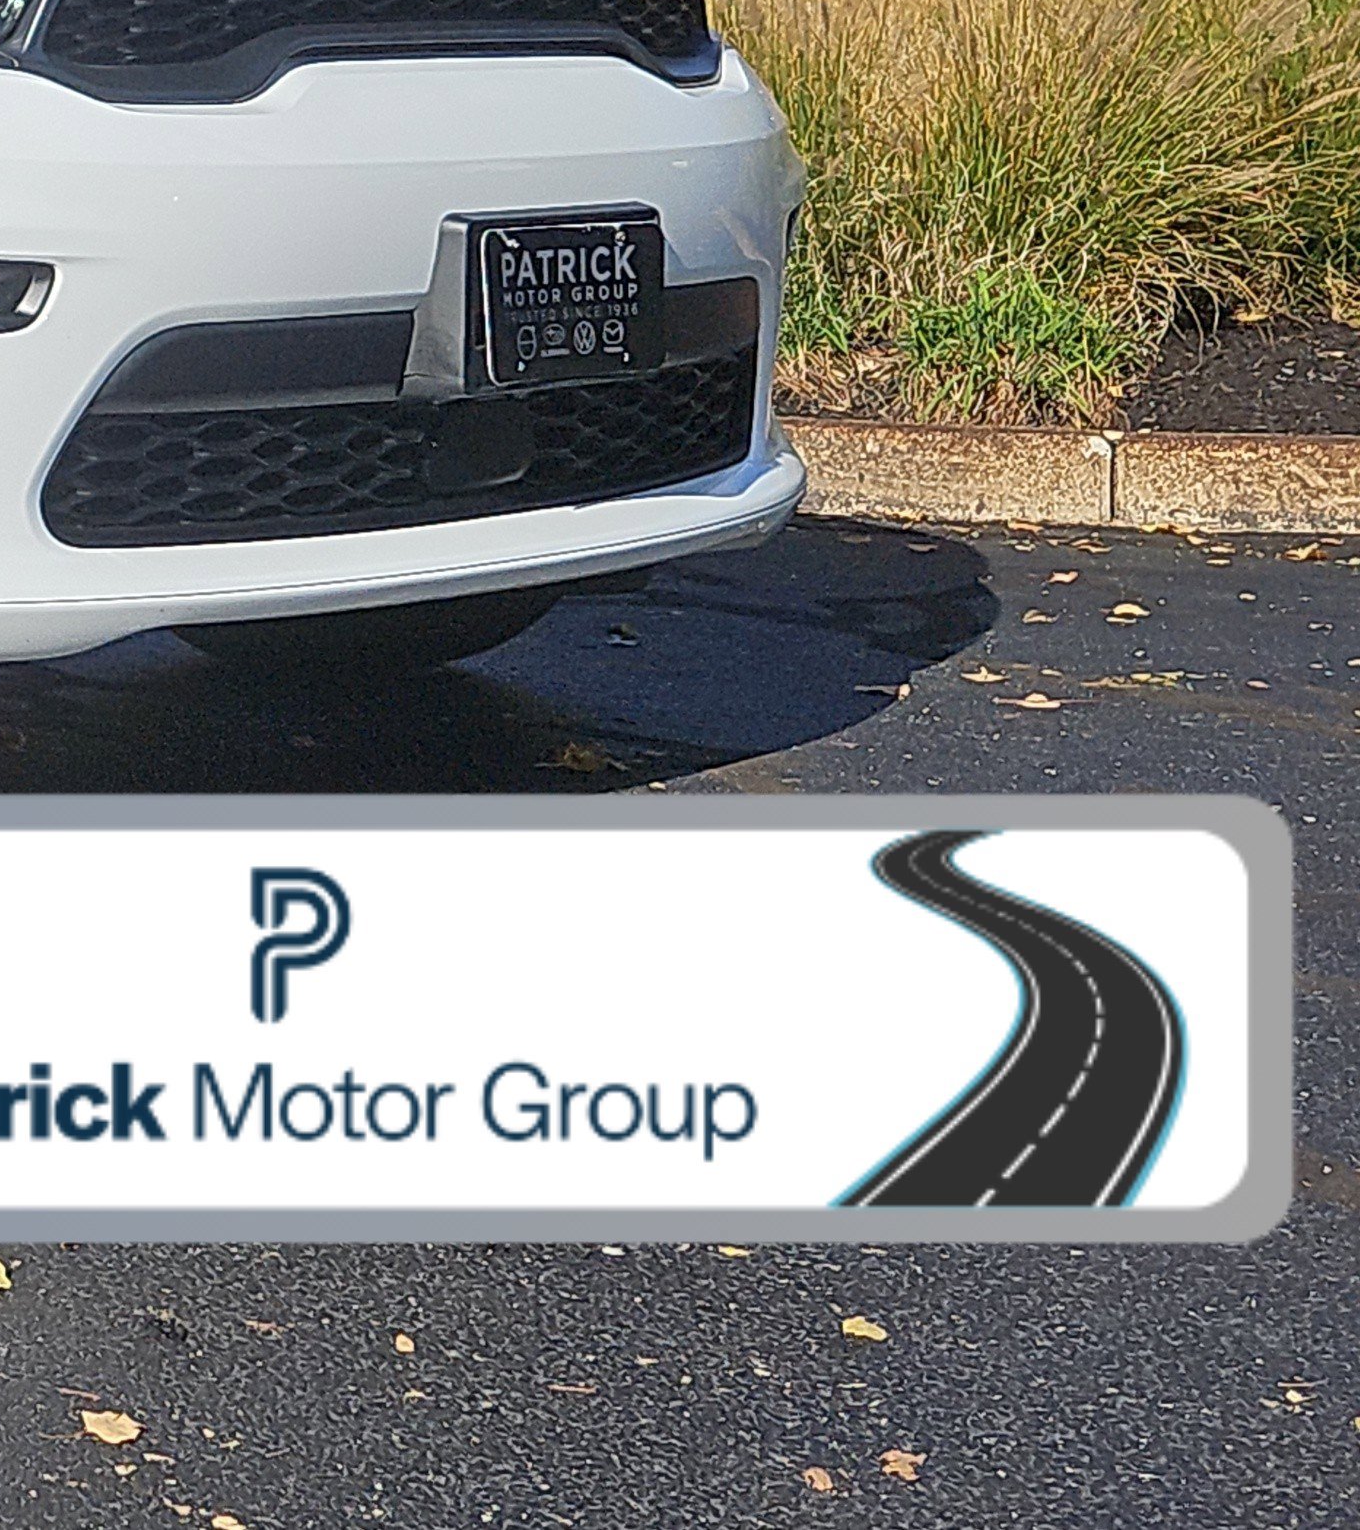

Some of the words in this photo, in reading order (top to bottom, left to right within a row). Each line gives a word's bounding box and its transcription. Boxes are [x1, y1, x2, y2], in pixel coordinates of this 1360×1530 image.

[500, 244, 637, 288] PATRICK
[502, 288, 562, 307] MOTOR
[571, 282, 638, 303] GROUP
